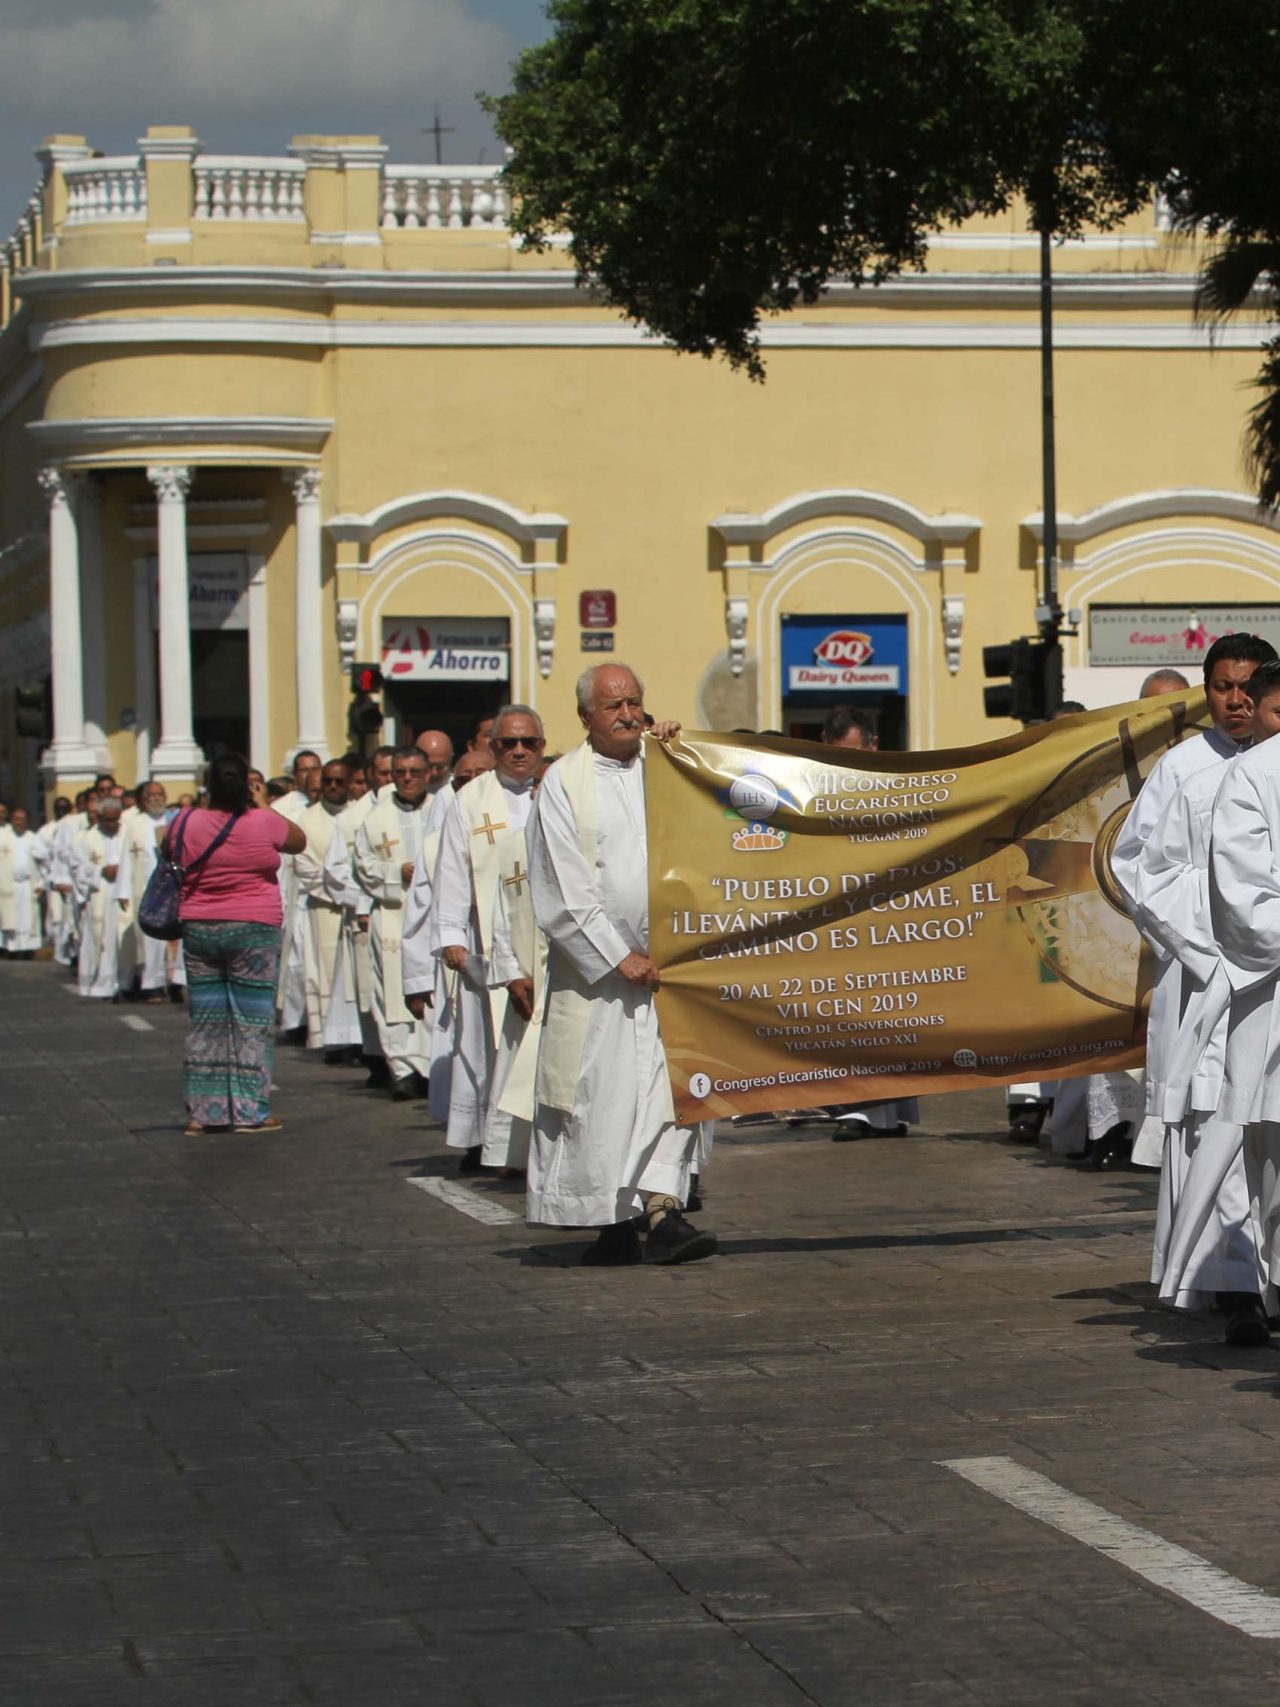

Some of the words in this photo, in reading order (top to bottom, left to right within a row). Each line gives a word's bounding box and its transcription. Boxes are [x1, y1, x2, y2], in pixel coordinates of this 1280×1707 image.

[429, 649, 501, 670] Ahorro
[827, 641, 864, 661] DQ
[798, 669, 838, 684] Dairy
[842, 670, 889, 683] Queen
[841, 773, 957, 793] CONGRESO
[741, 792, 767, 804] IHS
[815, 788, 950, 813] EUCARÍSTICO
[828, 808, 938, 830] NACIONAL
[904, 827, 928, 839] 2019
[842, 873, 877, 894] DE
[887, 854, 965, 881] DIOS:
[845, 898, 858, 914] Y
[870, 886, 960, 913] COME,
[970, 882, 1001, 903] EL
[699, 931, 819, 961] CAMINO
[830, 927, 858, 949] ES
[718, 984, 742, 1001] 20
[749, 984, 773, 999] AL
[778, 978, 803, 997] 22
[811, 977, 837, 994] DE
[844, 965, 967, 991] SEPTIEMBRE
[776, 1002, 809, 1019] VII
[816, 997, 862, 1018] CEN
[871, 991, 919, 1013] 2019
[755, 1024, 811, 1038] CENTRO
[816, 1023, 833, 1034] DE
[837, 1014, 945, 1033] CONVENCIONES
[850, 1033, 890, 1047] SIGLO
[894, 1033, 918, 1045] XXI
[981, 1039, 1126, 1066] http://cen2019.org.mx
[714, 1074, 776, 1093] Congreso
[779, 1066, 848, 1084] Eucarístico
[851, 1061, 907, 1076] Nacional
[910, 1059, 943, 1071] 2019
